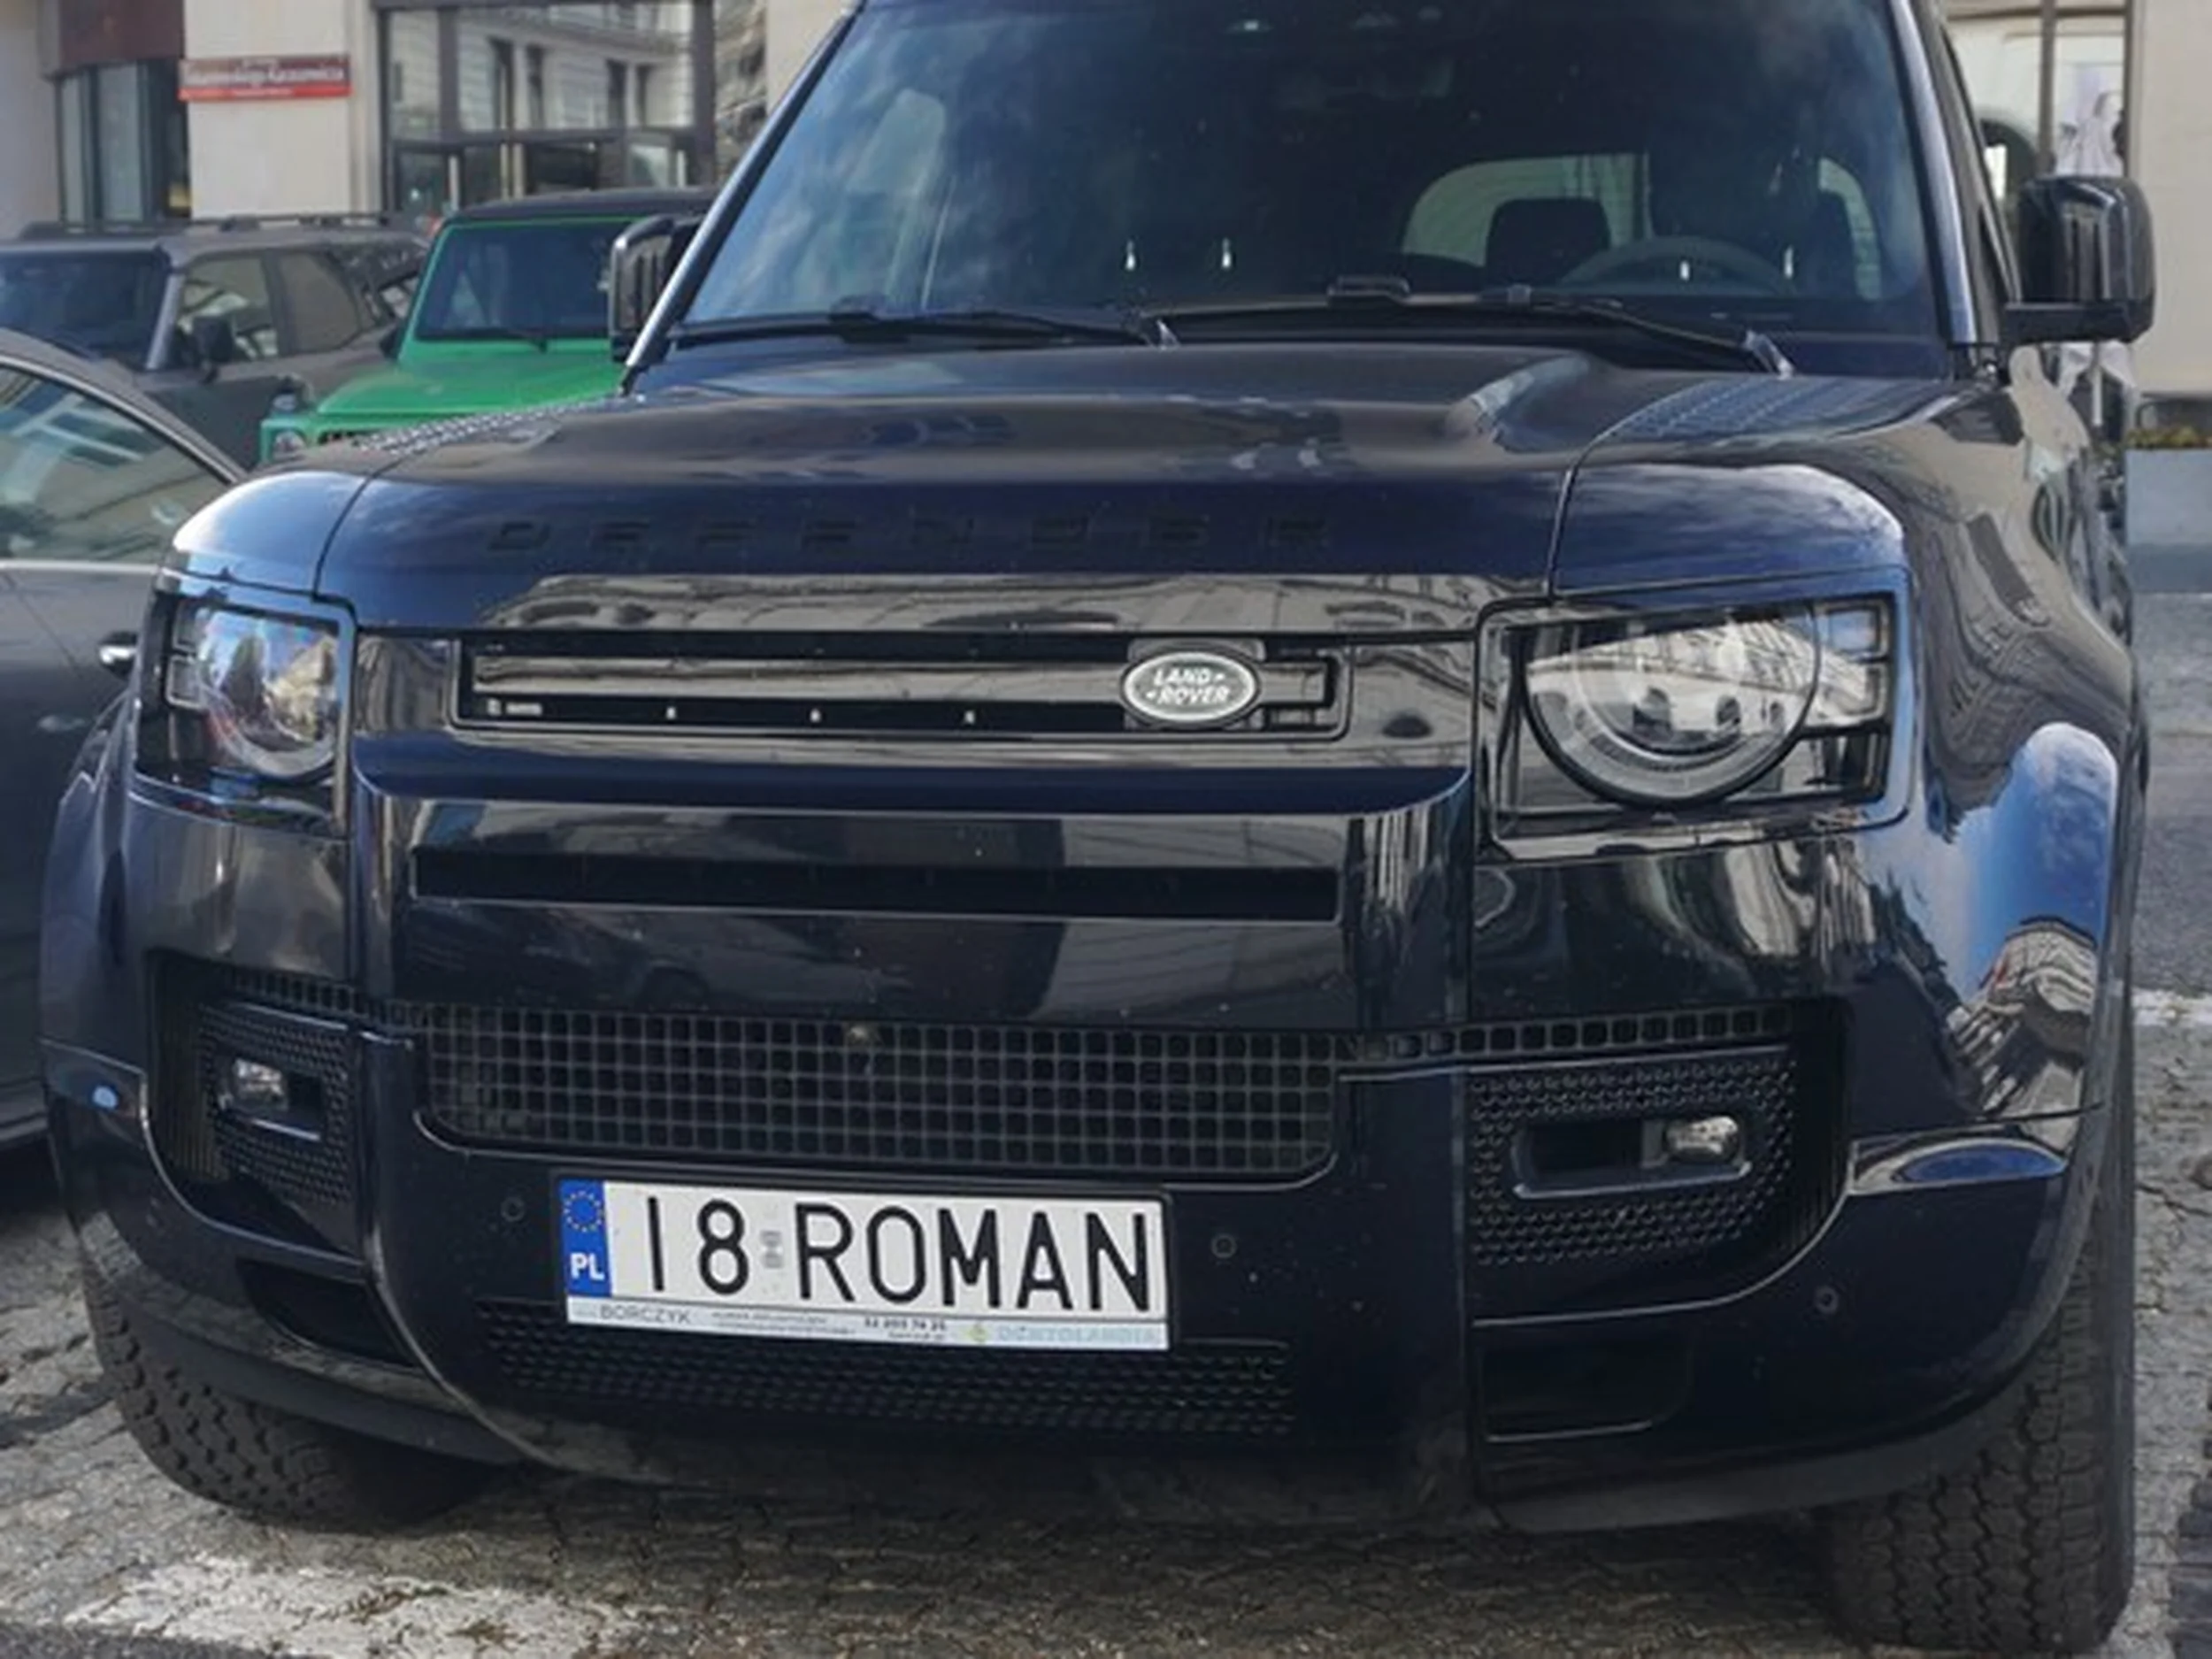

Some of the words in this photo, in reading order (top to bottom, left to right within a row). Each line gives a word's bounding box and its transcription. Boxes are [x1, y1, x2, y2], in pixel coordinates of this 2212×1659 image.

[485, 516, 1331, 552] DEFENDER
[1153, 667, 1212, 686] LAND
[1156, 685, 1231, 705] ROVER
[570, 1252, 605, 1280] PL
[795, 1202, 1149, 1312] ROMAN
